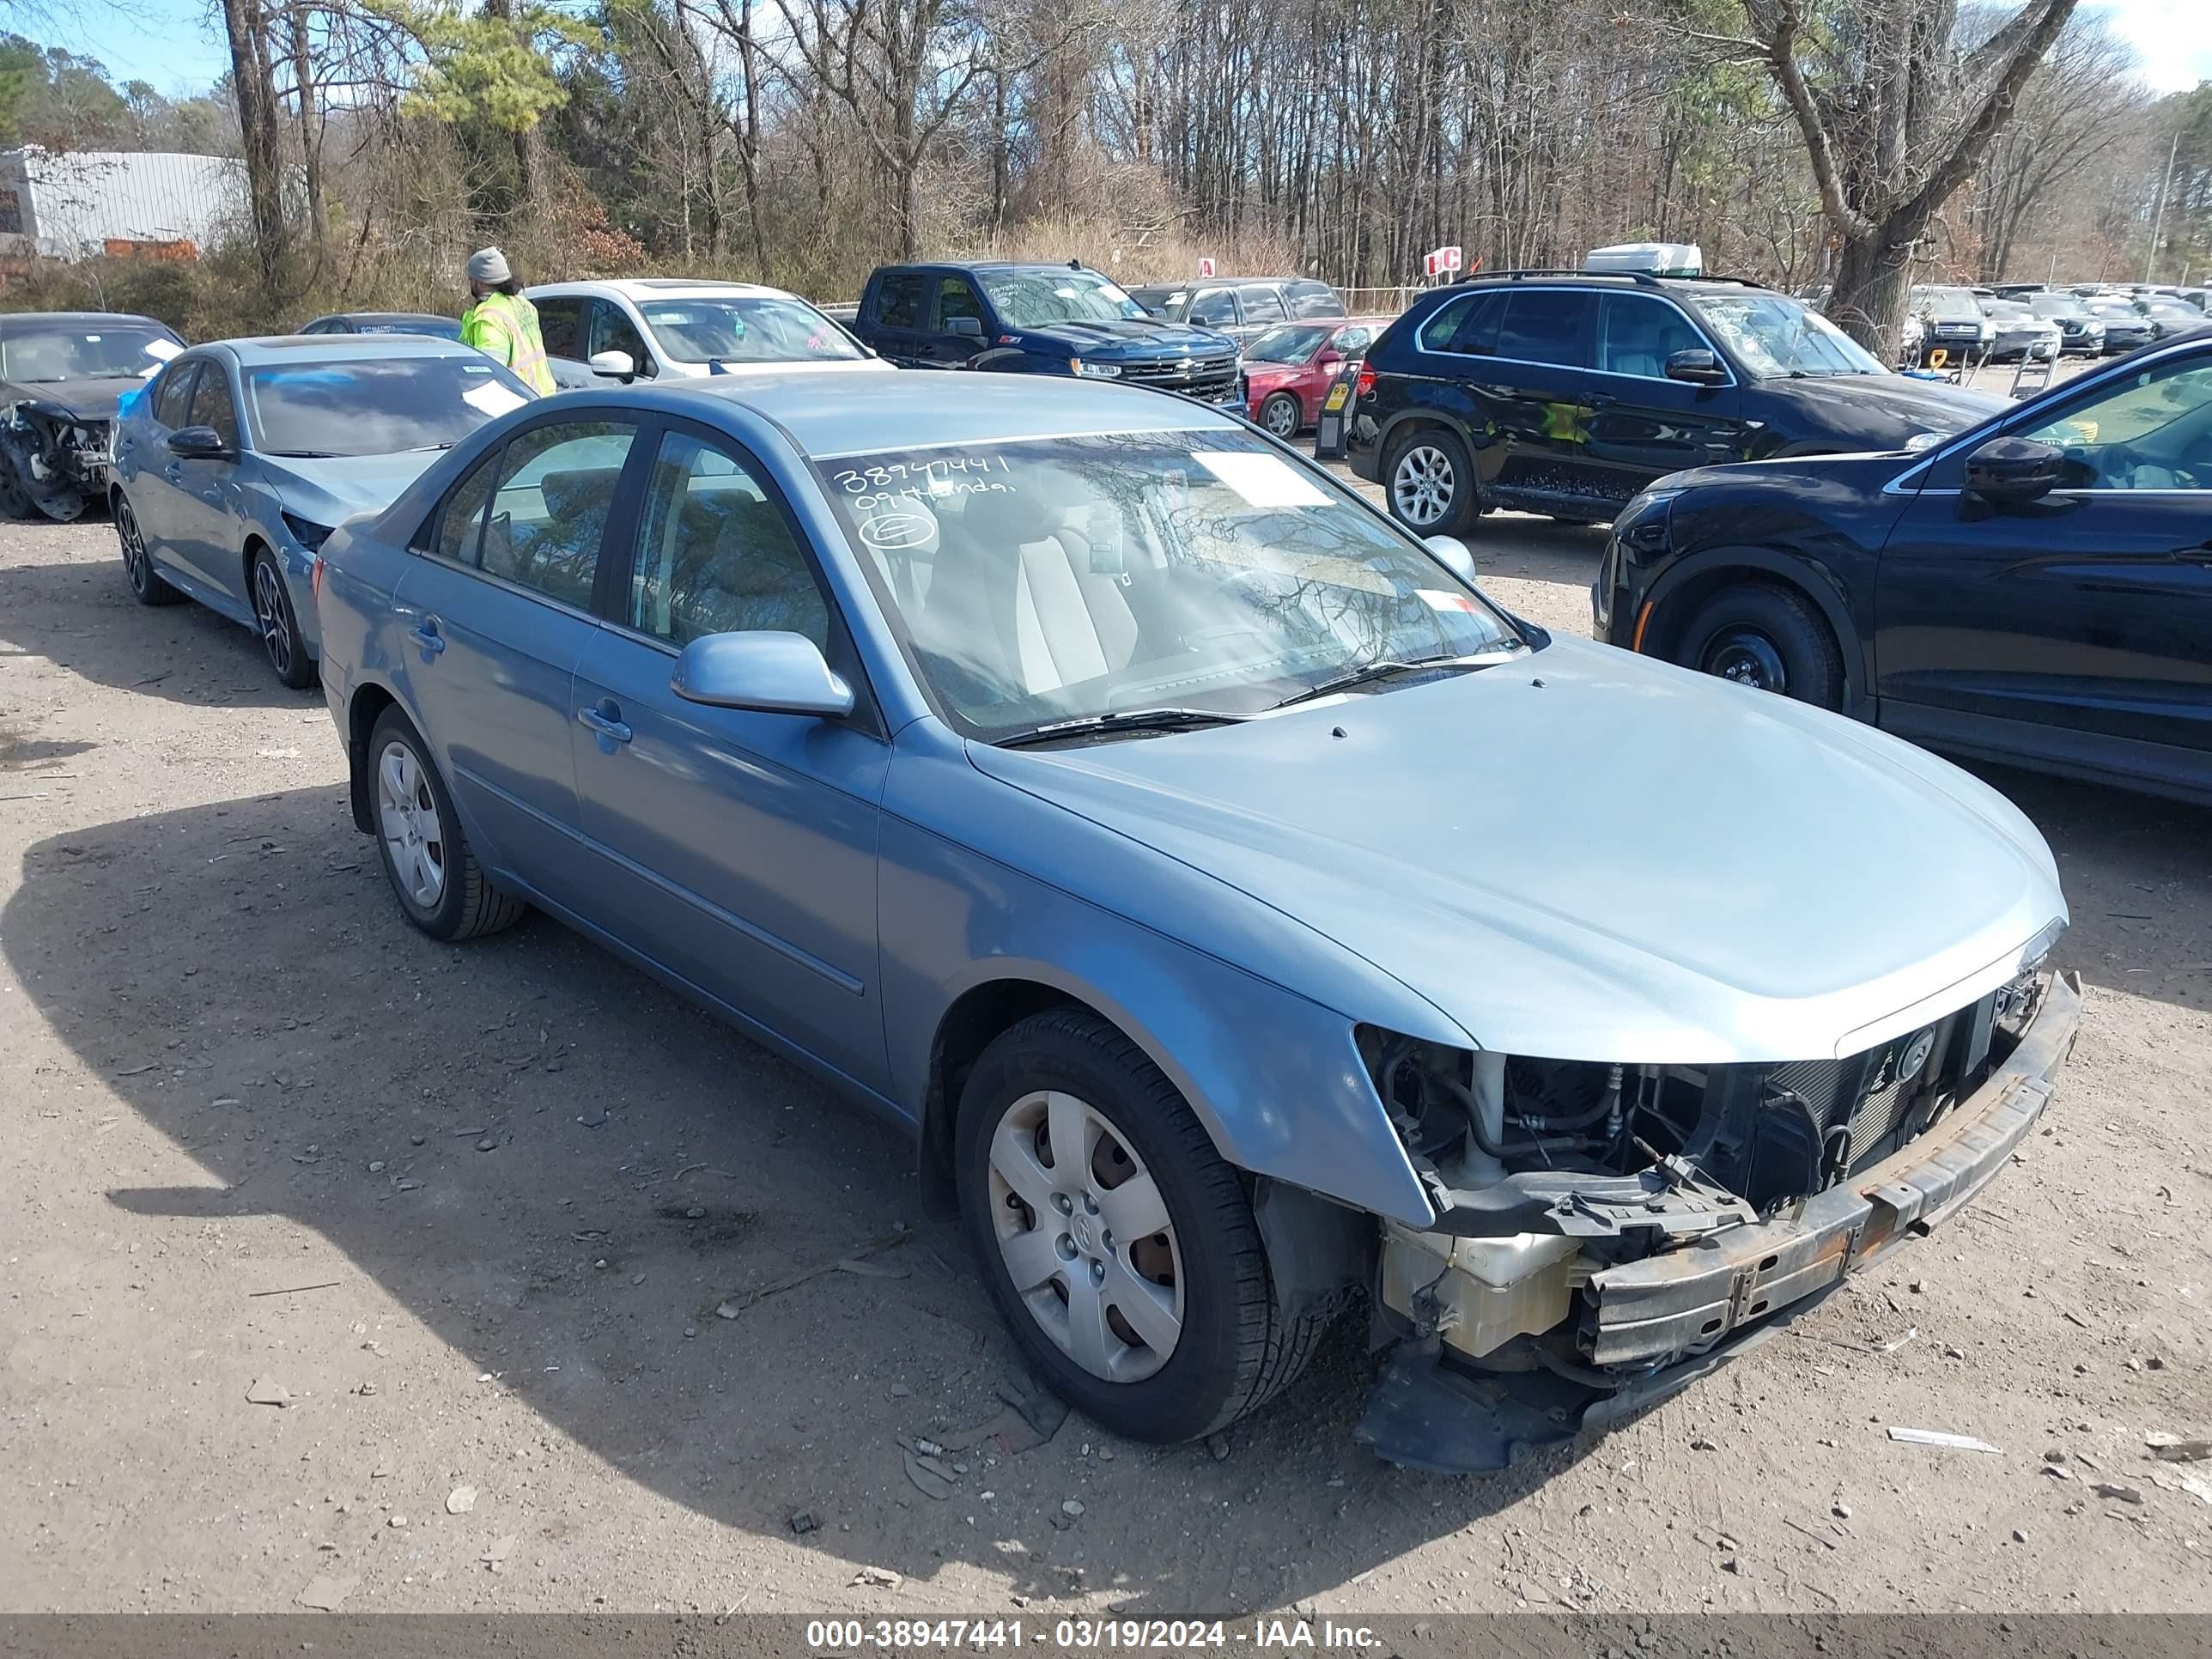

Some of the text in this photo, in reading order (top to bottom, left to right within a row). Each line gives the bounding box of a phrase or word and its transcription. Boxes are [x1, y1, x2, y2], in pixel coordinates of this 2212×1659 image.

[1203, 260, 1212, 276] A
[1443, 249, 1459, 268] C
[833, 455, 1011, 493] 38947441
